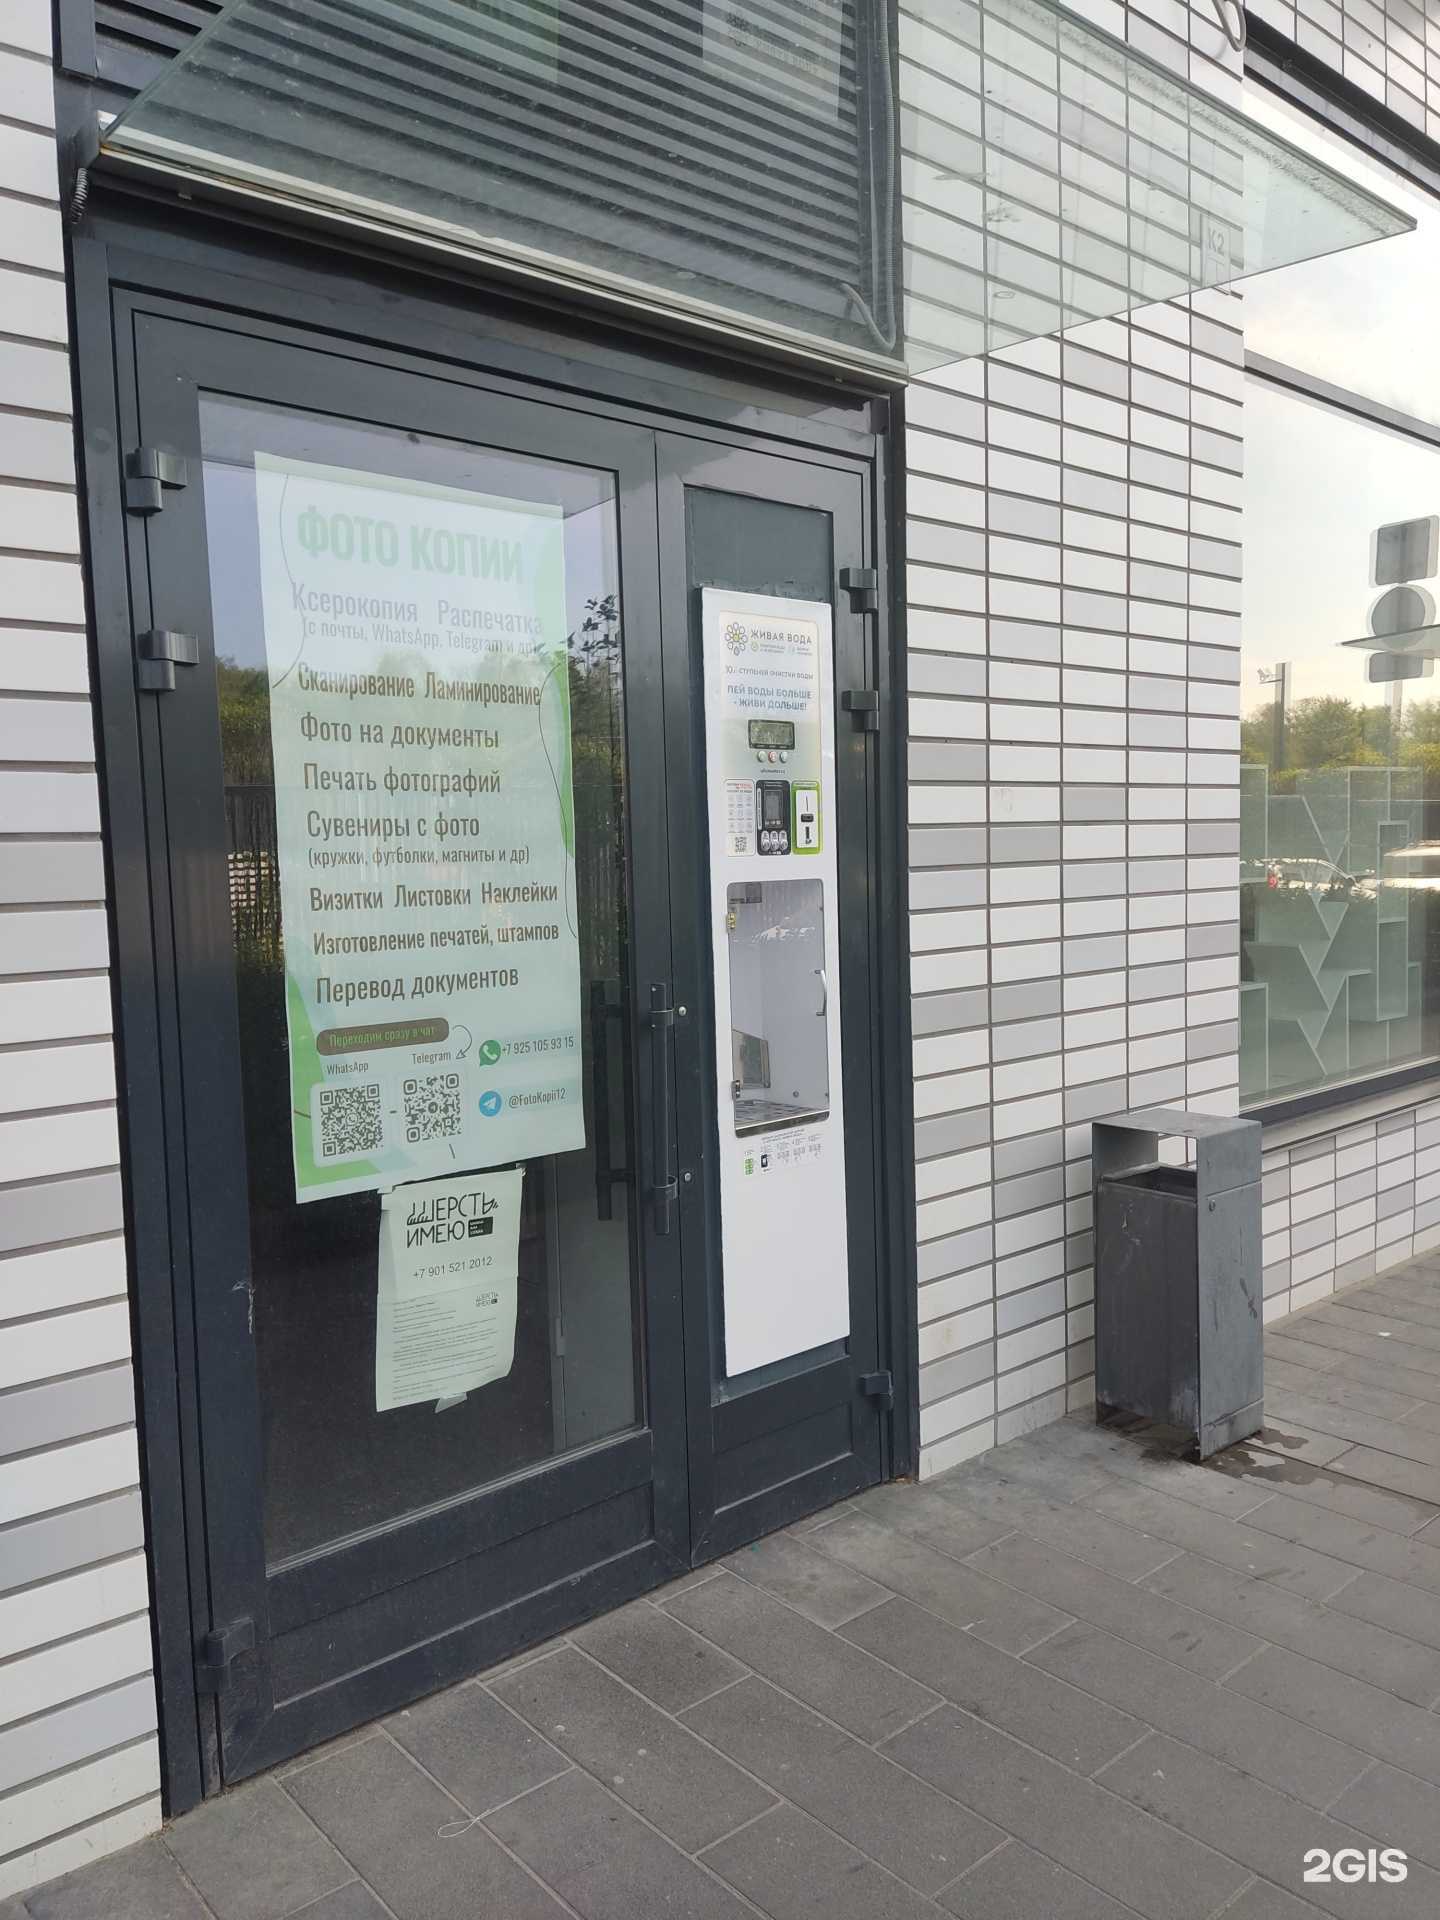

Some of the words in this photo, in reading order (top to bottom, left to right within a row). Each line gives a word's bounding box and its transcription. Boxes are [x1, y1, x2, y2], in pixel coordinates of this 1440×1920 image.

[297, 505, 400, 568] ФОТО
[410, 525, 523, 583] КОПИИ
[291, 582, 418, 623] Ксерокопия
[438, 599, 544, 635] Распечатка
[321, 622, 369, 641] почты,
[446, 631, 503, 654] Telegram
[505, 640, 514, 652] и
[750, 629, 784, 641] ЖИВАЯ
[787, 633, 813, 645] ВОДА
[298, 662, 415, 701] Сканирование
[424, 671, 541, 708] Ламинирование
[727, 684, 746, 695] ПЕЙ
[748, 686, 774, 697] ВОДЫ
[776, 688, 811, 699] БОЛЬШЕ
[739, 698, 766, 708] ЖИВИ
[767, 701, 807, 711] ДОЛЬШЕ!
[300, 711, 352, 743] Фото
[360, 723, 383, 744] на
[390, 724, 499, 750] документы
[304, 762, 377, 792] Печать
[384, 766, 500, 797] фотографий
[307, 810, 410, 842] Сувениры
[417, 818, 427, 837] с
[434, 812, 480, 842] фото
[308, 848, 368, 868] (кружки,
[372, 846, 438, 868] футболки,
[442, 848, 495, 864] магниты
[498, 848, 506, 862] и
[510, 846, 530, 865] др)
[309, 886, 384, 912] Визитки
[394, 884, 471, 909] Листовки
[481, 881, 558, 905] Наклейки
[313, 932, 425, 956] Изготовление
[429, 924, 494, 948] печатей,
[497, 923, 559, 944] штампов
[315, 976, 405, 1007] Перевод
[411, 968, 519, 999] документов
[411, 1051, 452, 1065] Telegram
[502, 1043, 511, 1055] +7
[513, 1041, 530, 1054] 925
[533, 1040, 548, 1052] 105
[551, 1037, 562, 1050] 93
[564, 1036, 574, 1049] 15
[327, 1062, 369, 1075] WhatsApp
[407, 1192, 498, 1226] ШЕРСТЬ
[407, 1220, 465, 1248] ИМЕЮ
[412, 1267, 426, 1279] +7
[428, 1264, 446, 1277] 901
[449, 1260, 466, 1273] 521
[469, 1256, 493, 1269] 2012
